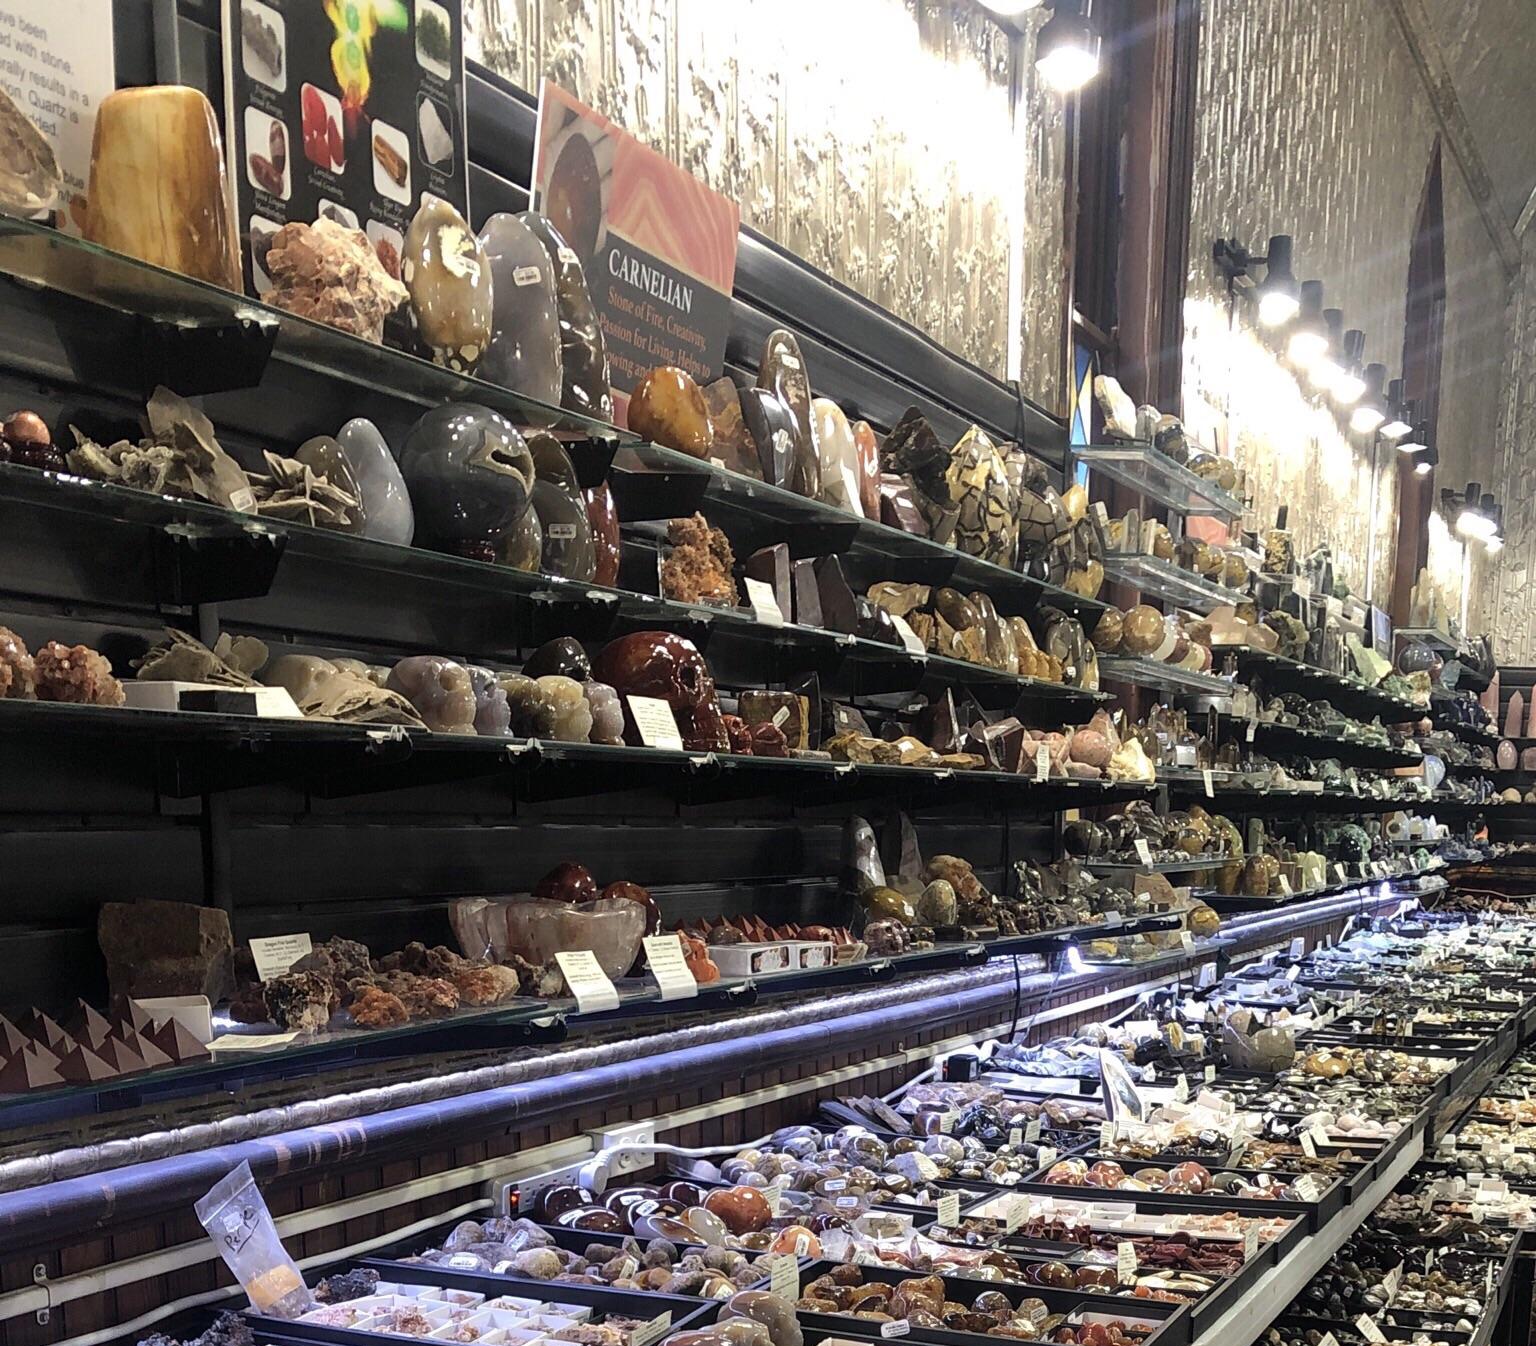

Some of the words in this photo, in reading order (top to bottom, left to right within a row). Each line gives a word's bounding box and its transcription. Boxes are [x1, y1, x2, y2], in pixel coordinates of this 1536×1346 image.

[19, 16, 48, 42] been
[15, 39, 37, 59] with
[41, 51, 74, 77] stone.
[28, 89, 67, 119] Quartz
[29, 71, 66, 97] results
[69, 88, 79, 102] in
[82, 94, 89, 107] a
[608, 248, 693, 314] CARNELIAN
[608, 286, 633, 313] Stone
[635, 301, 646, 320] of
[599, 312, 632, 343] Passion
[633, 328, 647, 351] for
[677, 348, 701, 376] Helps
[702, 363, 711, 378] to
